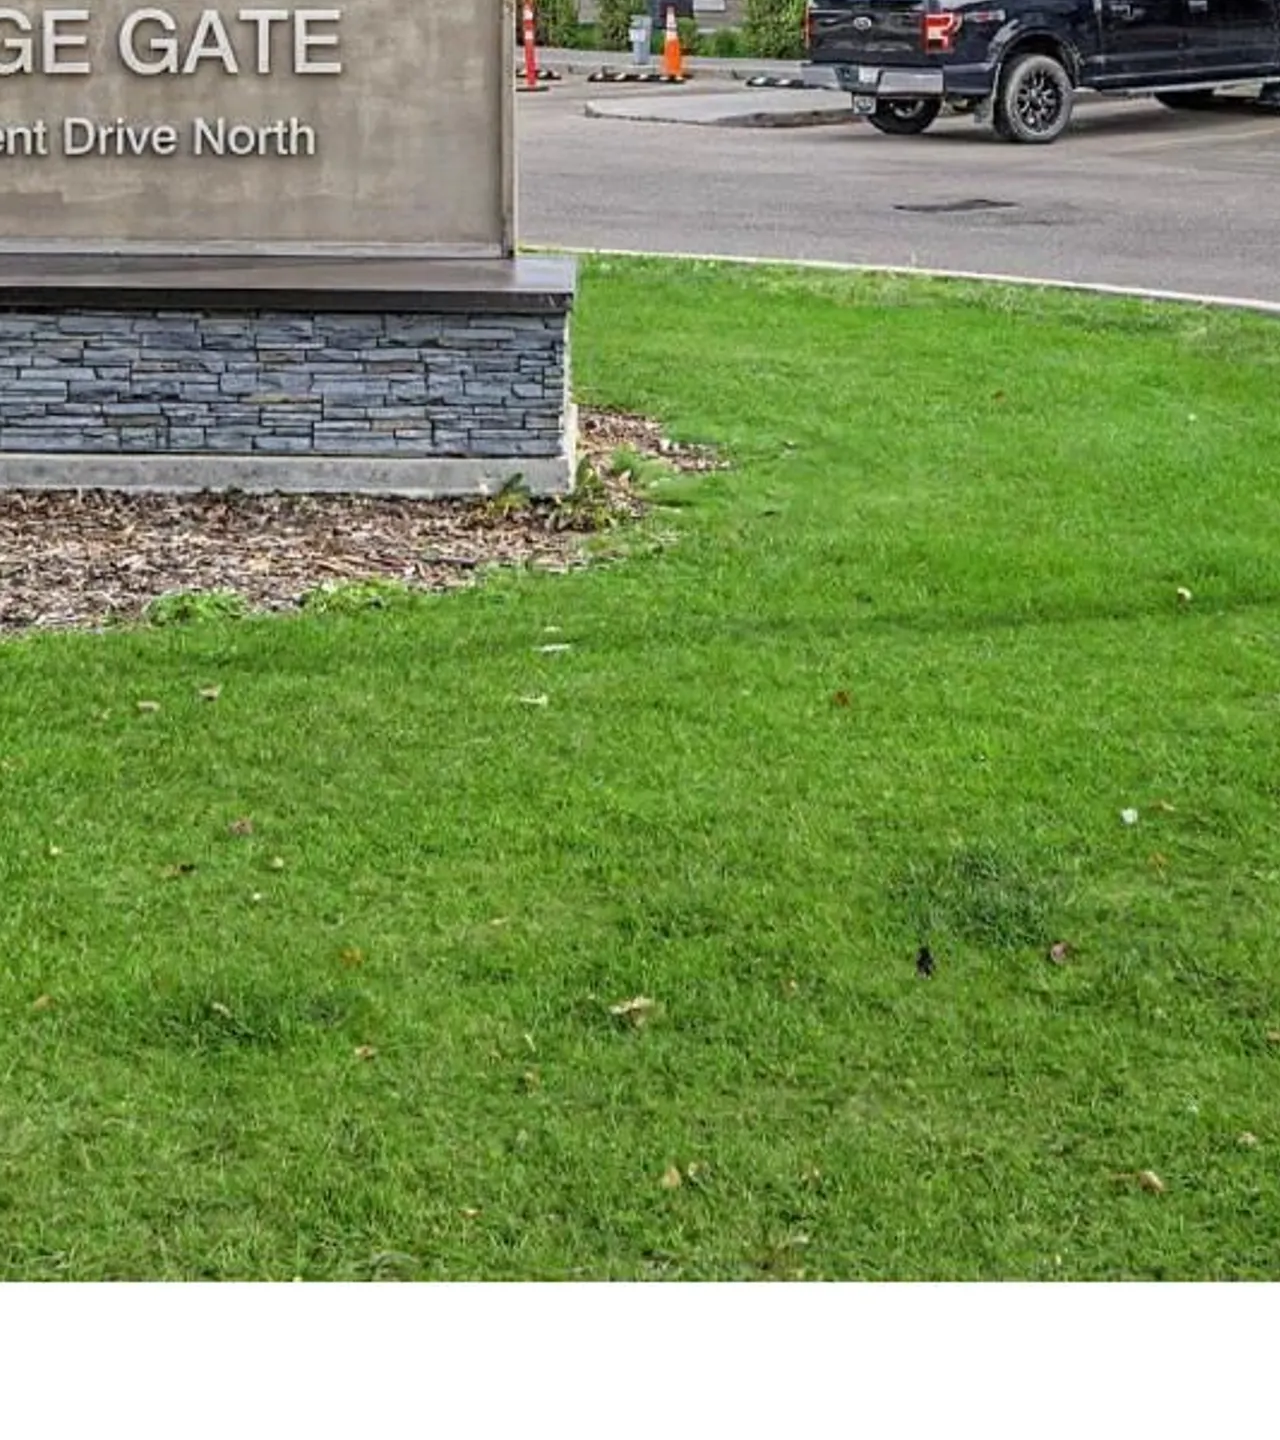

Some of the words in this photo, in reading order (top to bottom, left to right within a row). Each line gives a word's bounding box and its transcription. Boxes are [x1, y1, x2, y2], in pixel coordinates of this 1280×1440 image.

[119, 8, 342, 75] GATE
[63, 117, 176, 156] Drive
[194, 117, 315, 156] North
